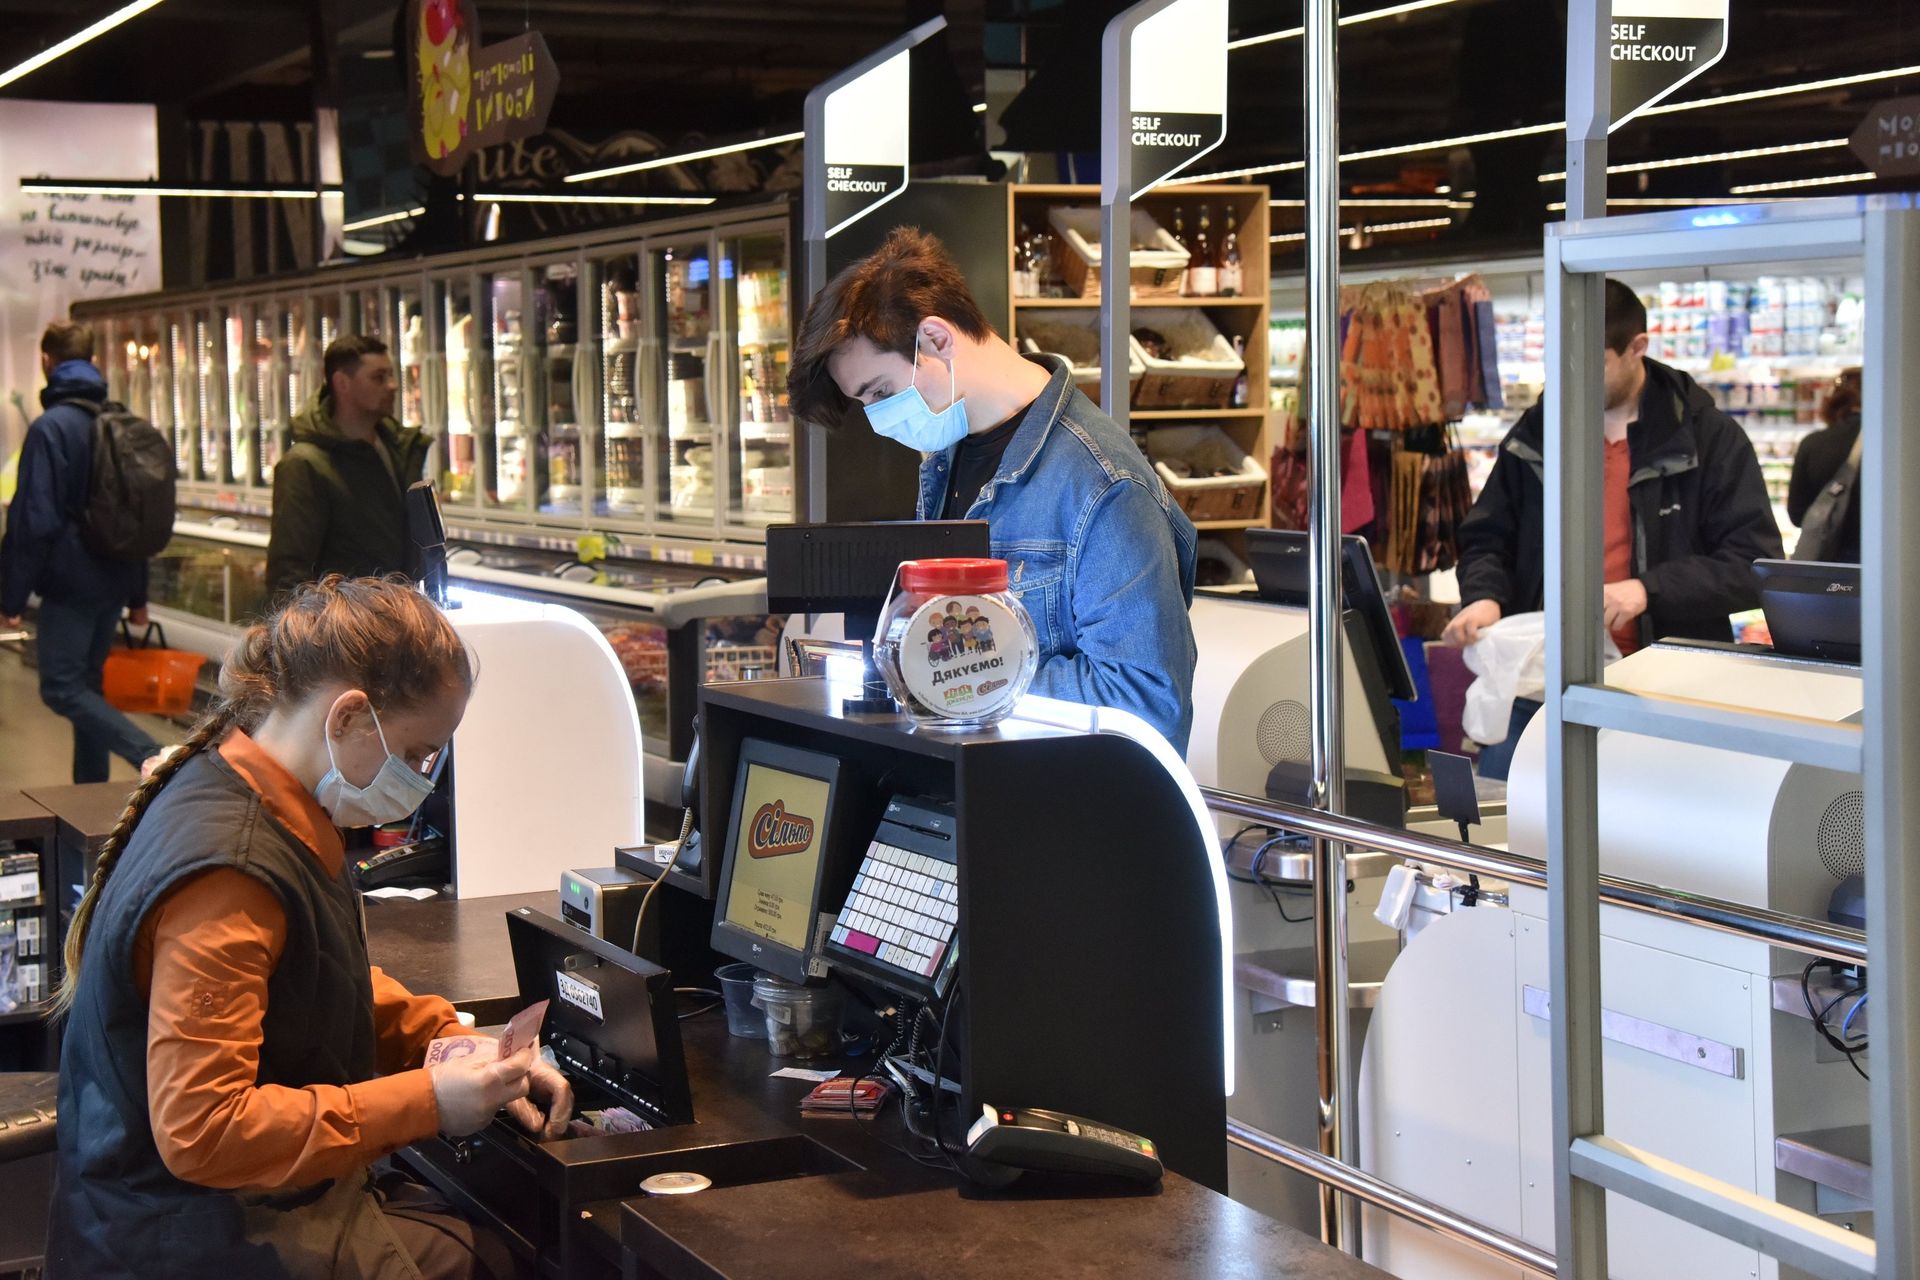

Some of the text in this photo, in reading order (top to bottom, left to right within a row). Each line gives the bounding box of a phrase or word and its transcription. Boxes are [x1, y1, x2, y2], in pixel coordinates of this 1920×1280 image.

[1610, 24, 1646, 40] SELF
[1610, 44, 1697, 62] CHECKOUT
[1131, 116, 1161, 131] SELF
[1131, 132, 1202, 147] CHECKOUT
[827, 166, 853, 179] SELF
[827, 180, 887, 192] CHECKOUT
[754, 808, 811, 849] Сільпо
[429, 1041, 443, 1063] 200
